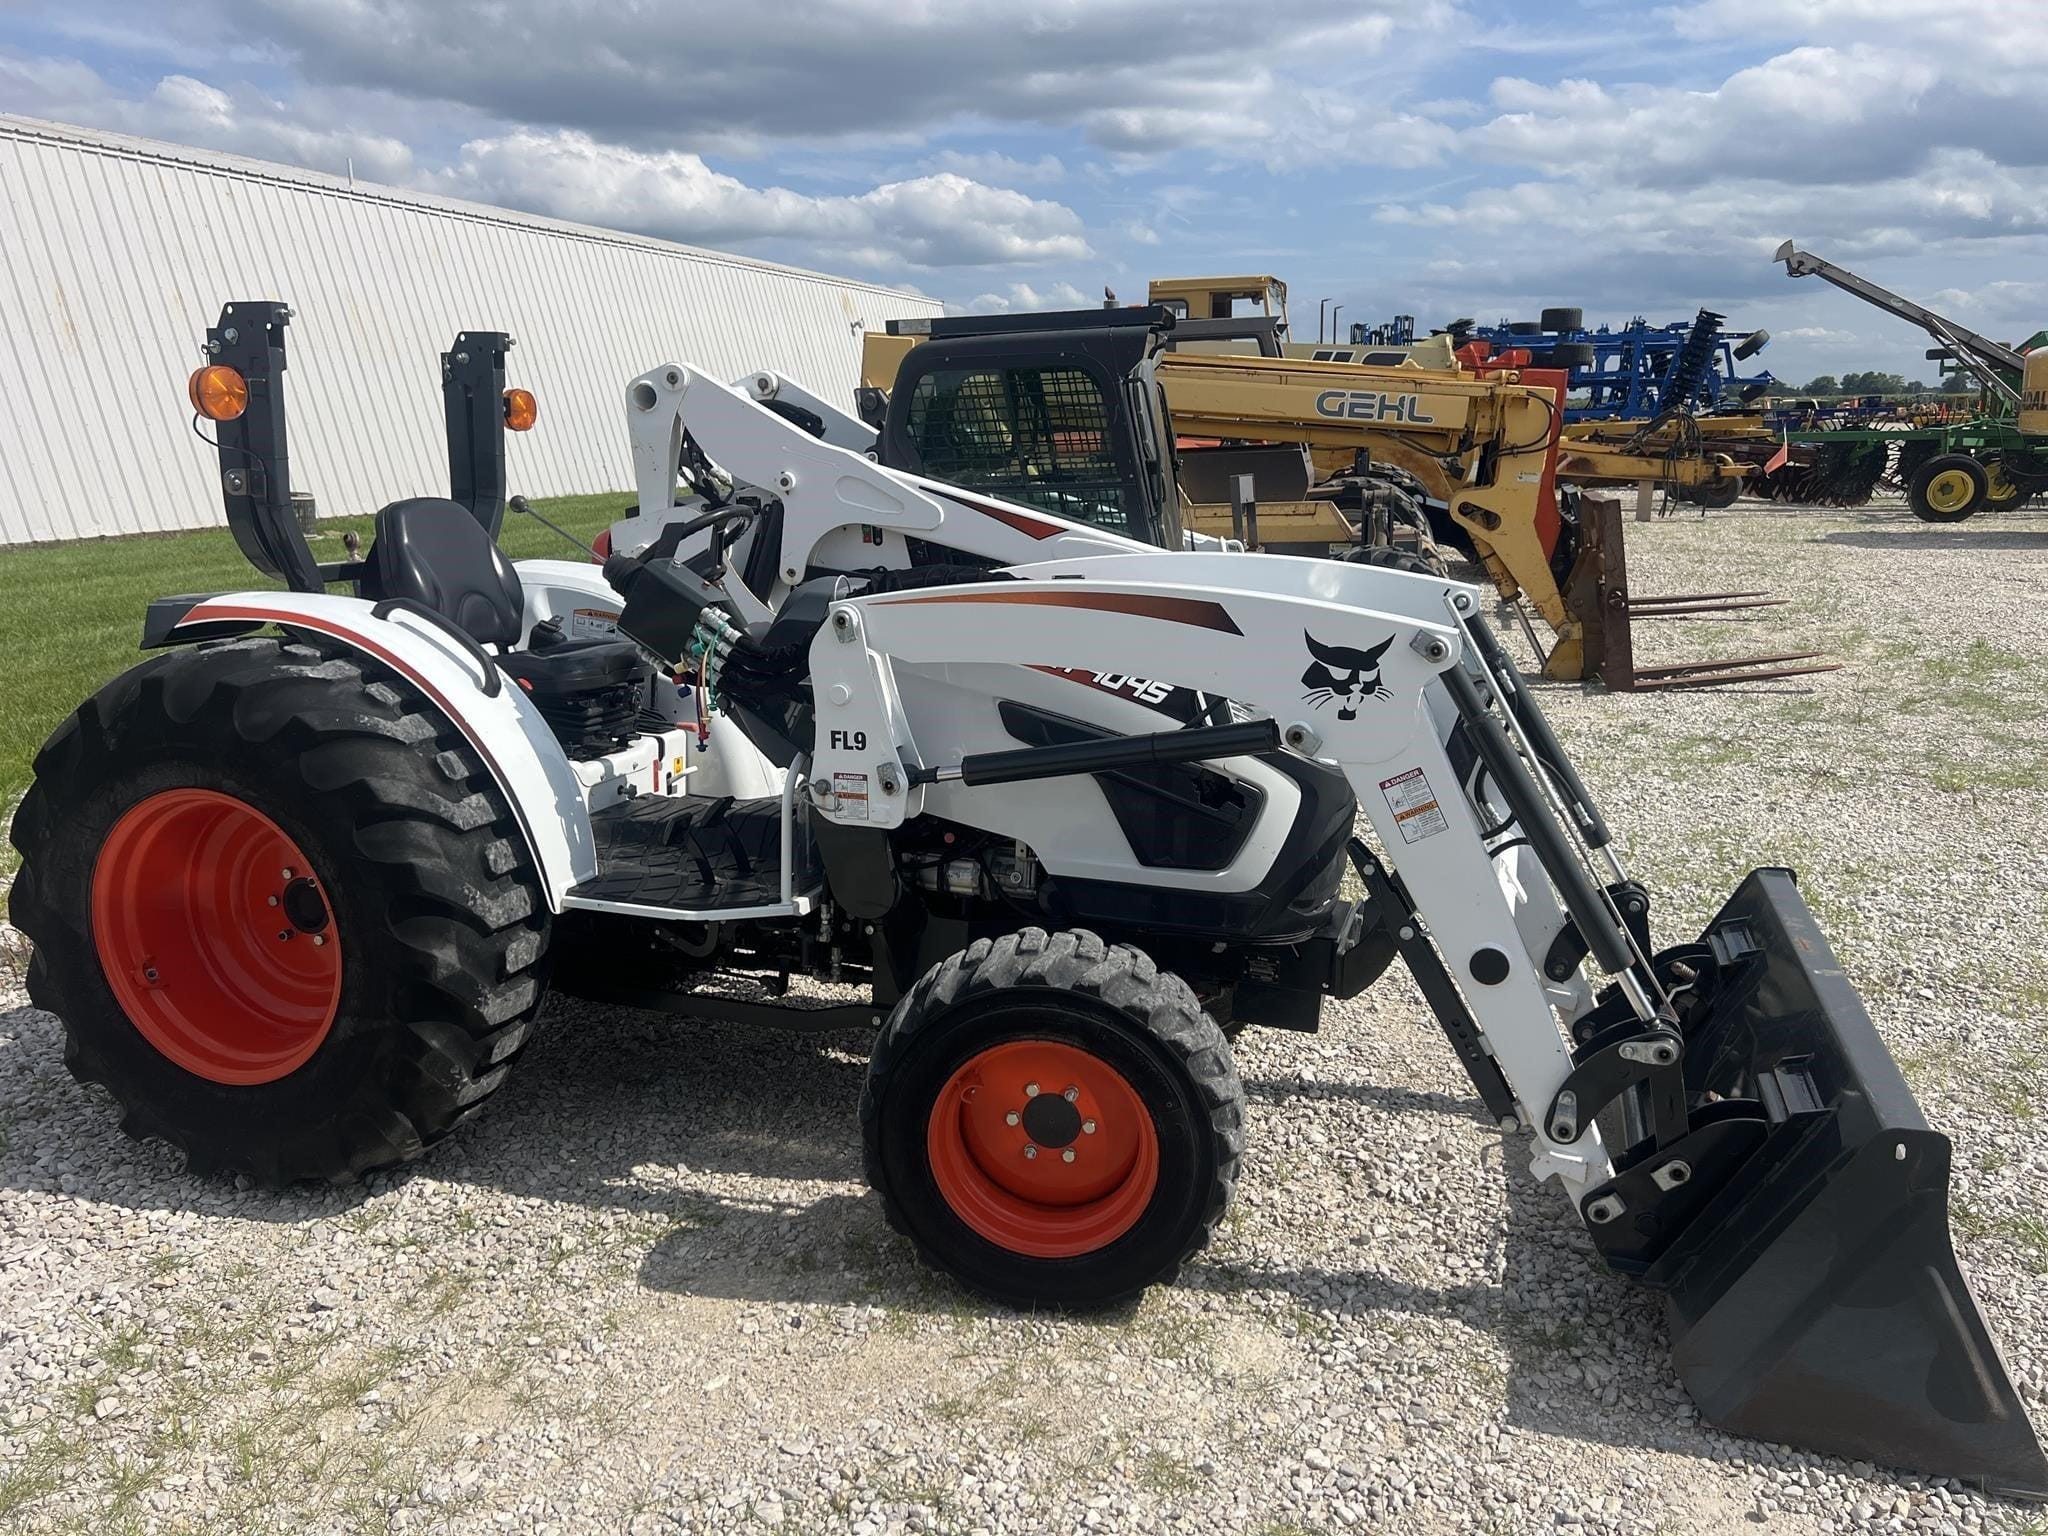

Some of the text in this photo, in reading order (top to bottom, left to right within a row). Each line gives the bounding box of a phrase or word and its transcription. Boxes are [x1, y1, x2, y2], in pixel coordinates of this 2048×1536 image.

[1316, 390, 1434, 423] GEHL
[830, 730, 867, 751] FL9
[1390, 769, 1420, 785] DANGER
[1405, 803, 1435, 818] WARNING
